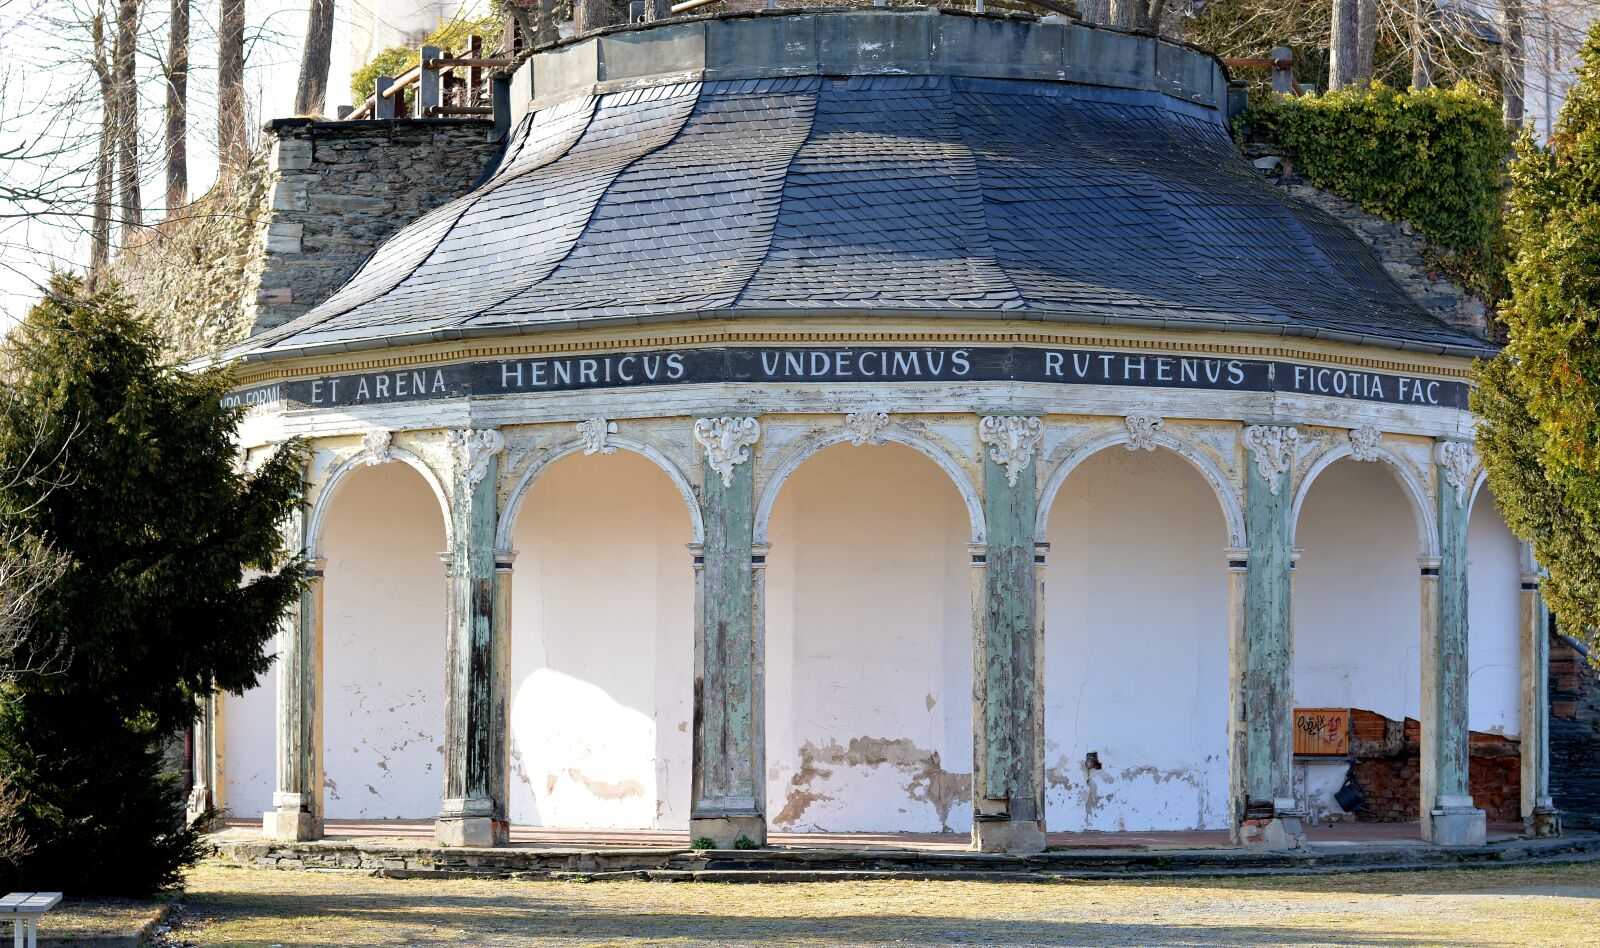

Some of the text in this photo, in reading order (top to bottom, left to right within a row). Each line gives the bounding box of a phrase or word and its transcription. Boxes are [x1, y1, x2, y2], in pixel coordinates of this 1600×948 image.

[311, 379, 340, 403] ET
[356, 369, 447, 400] ARENA
[1294, 366, 1384, 398] FICOTIA
[1398, 378, 1441, 404] FAC
